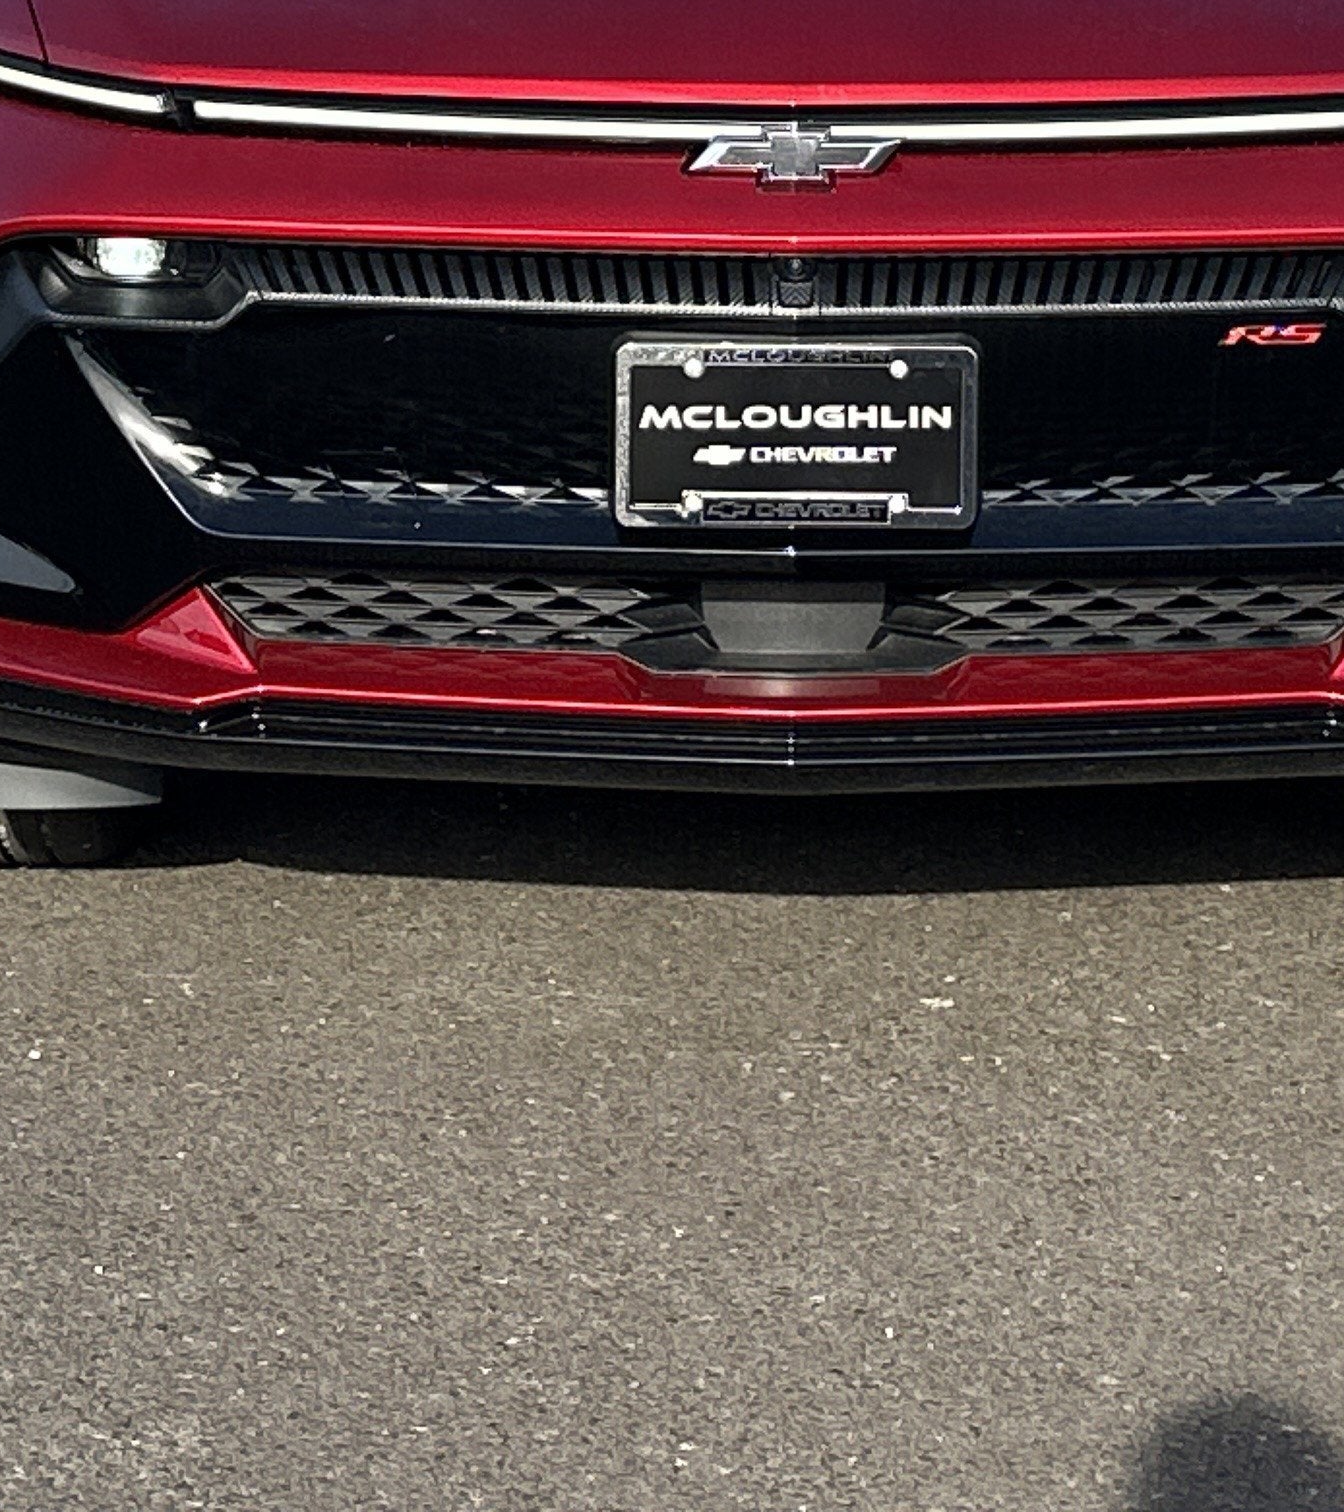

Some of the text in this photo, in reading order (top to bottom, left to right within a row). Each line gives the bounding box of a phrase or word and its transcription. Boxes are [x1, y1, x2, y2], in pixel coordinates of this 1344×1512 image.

[1219, 323, 1326, 346] RS
[638, 404, 952, 430] MCLOUGHLIN
[749, 445, 898, 464] CHEVROLET
[755, 502, 886, 519] CHEVROLET
